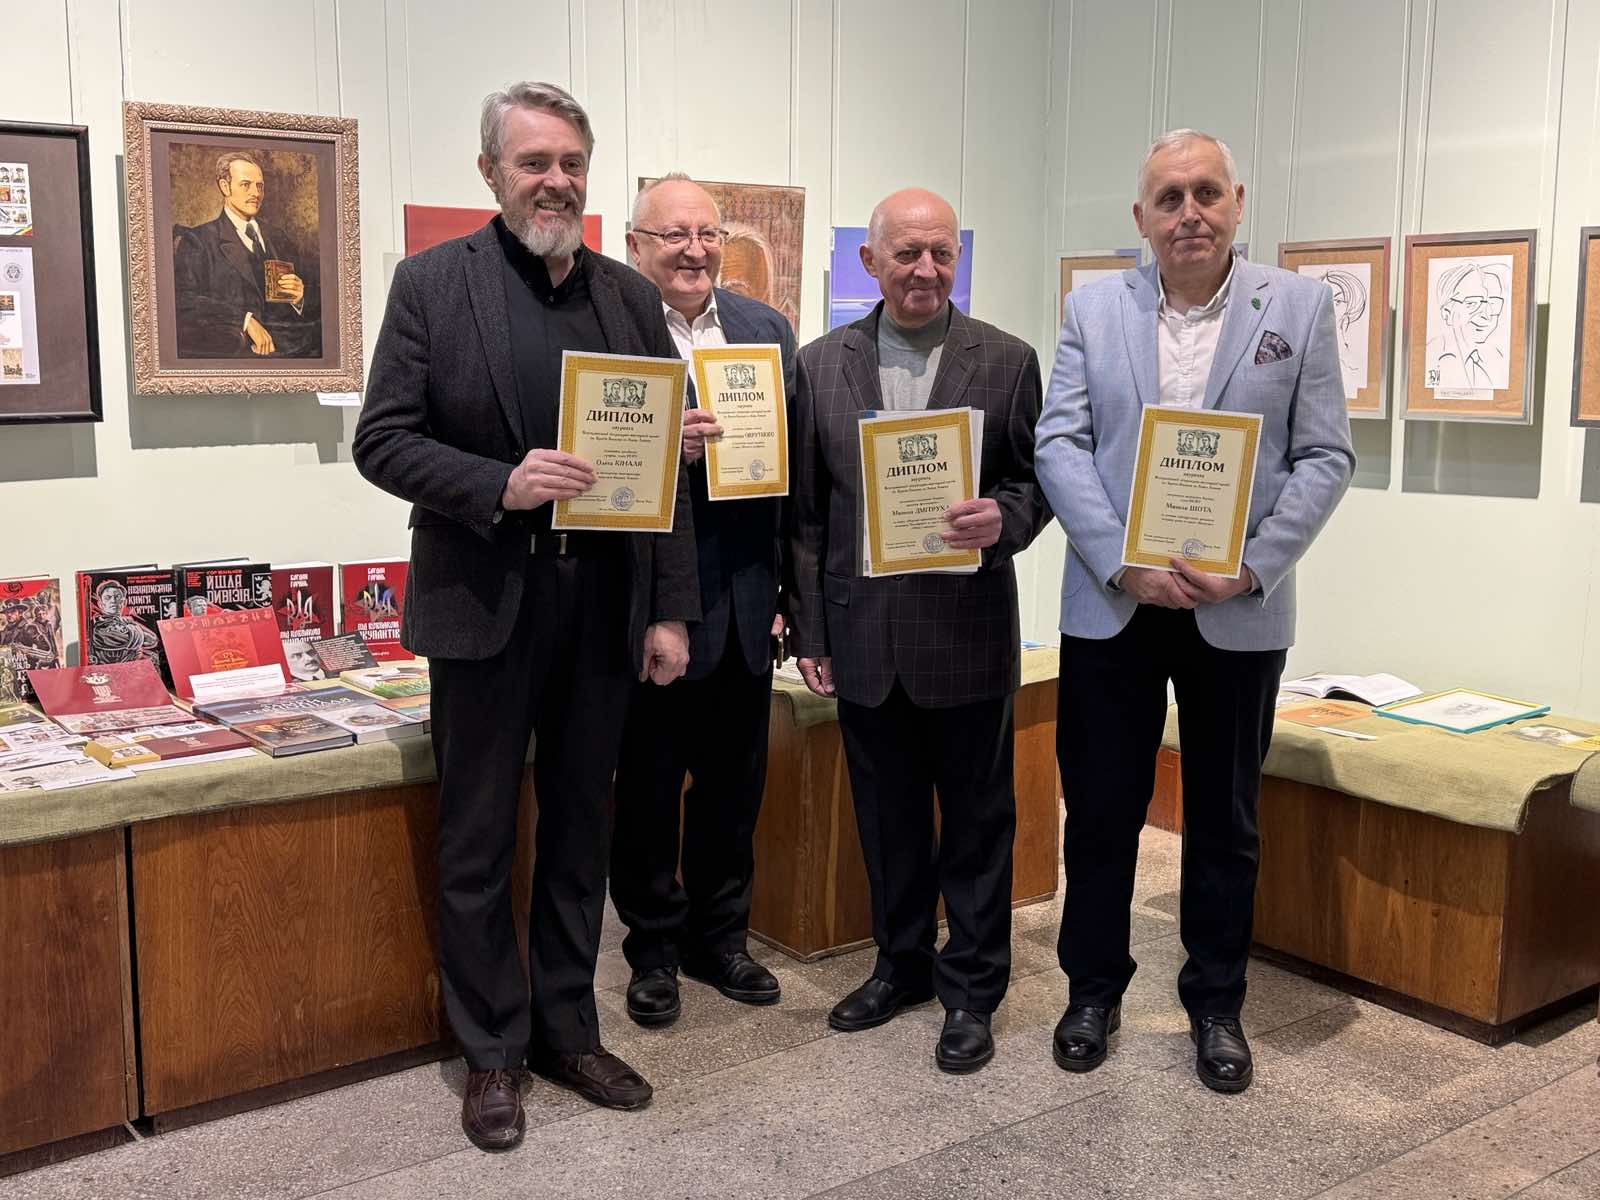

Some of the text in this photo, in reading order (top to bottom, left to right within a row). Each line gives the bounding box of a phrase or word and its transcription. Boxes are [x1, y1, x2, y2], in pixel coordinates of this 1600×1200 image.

[718, 391, 765, 403] ДИПЛОМ
[586, 410, 654, 425] ДИПЛОМ
[886, 461, 948, 478] ДИПЛОМ
[1160, 457, 1225, 473] ДИПЛОМ
[206, 574, 243, 591] ЙШЛА
